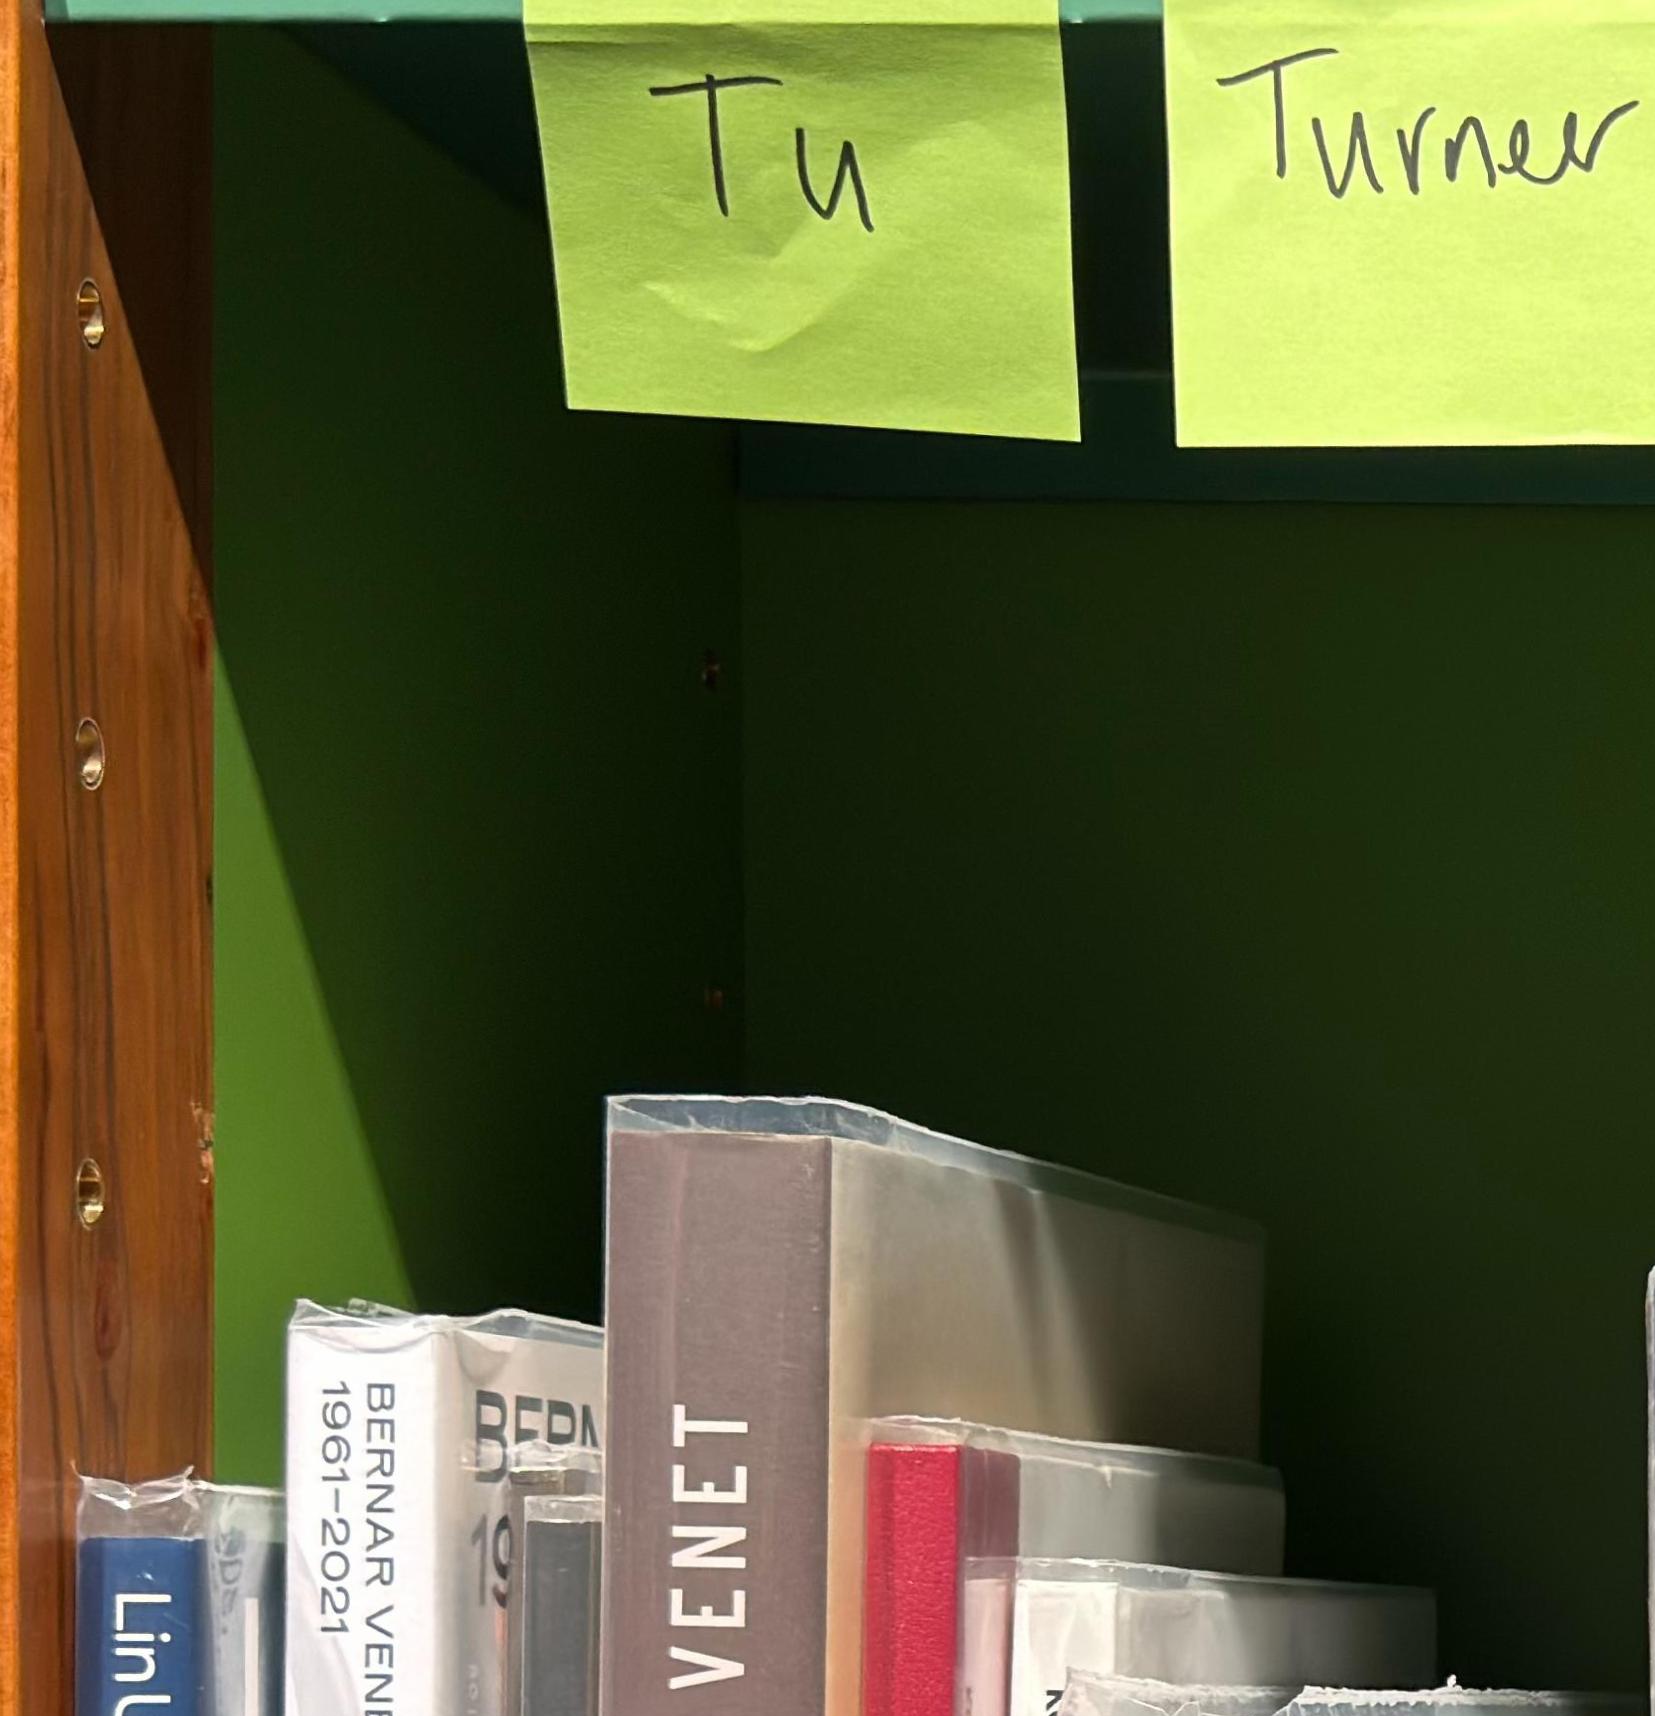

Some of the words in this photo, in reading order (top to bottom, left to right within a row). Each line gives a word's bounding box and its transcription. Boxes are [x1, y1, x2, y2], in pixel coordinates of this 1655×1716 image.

[650, 72, 875, 234] Tu
[1217, 47, 1641, 198] Turner
[366, 1382, 395, 1589] BERNAR
[667, 1404, 749, 1690] VENET
[114, 1594, 171, 1681] Lin
